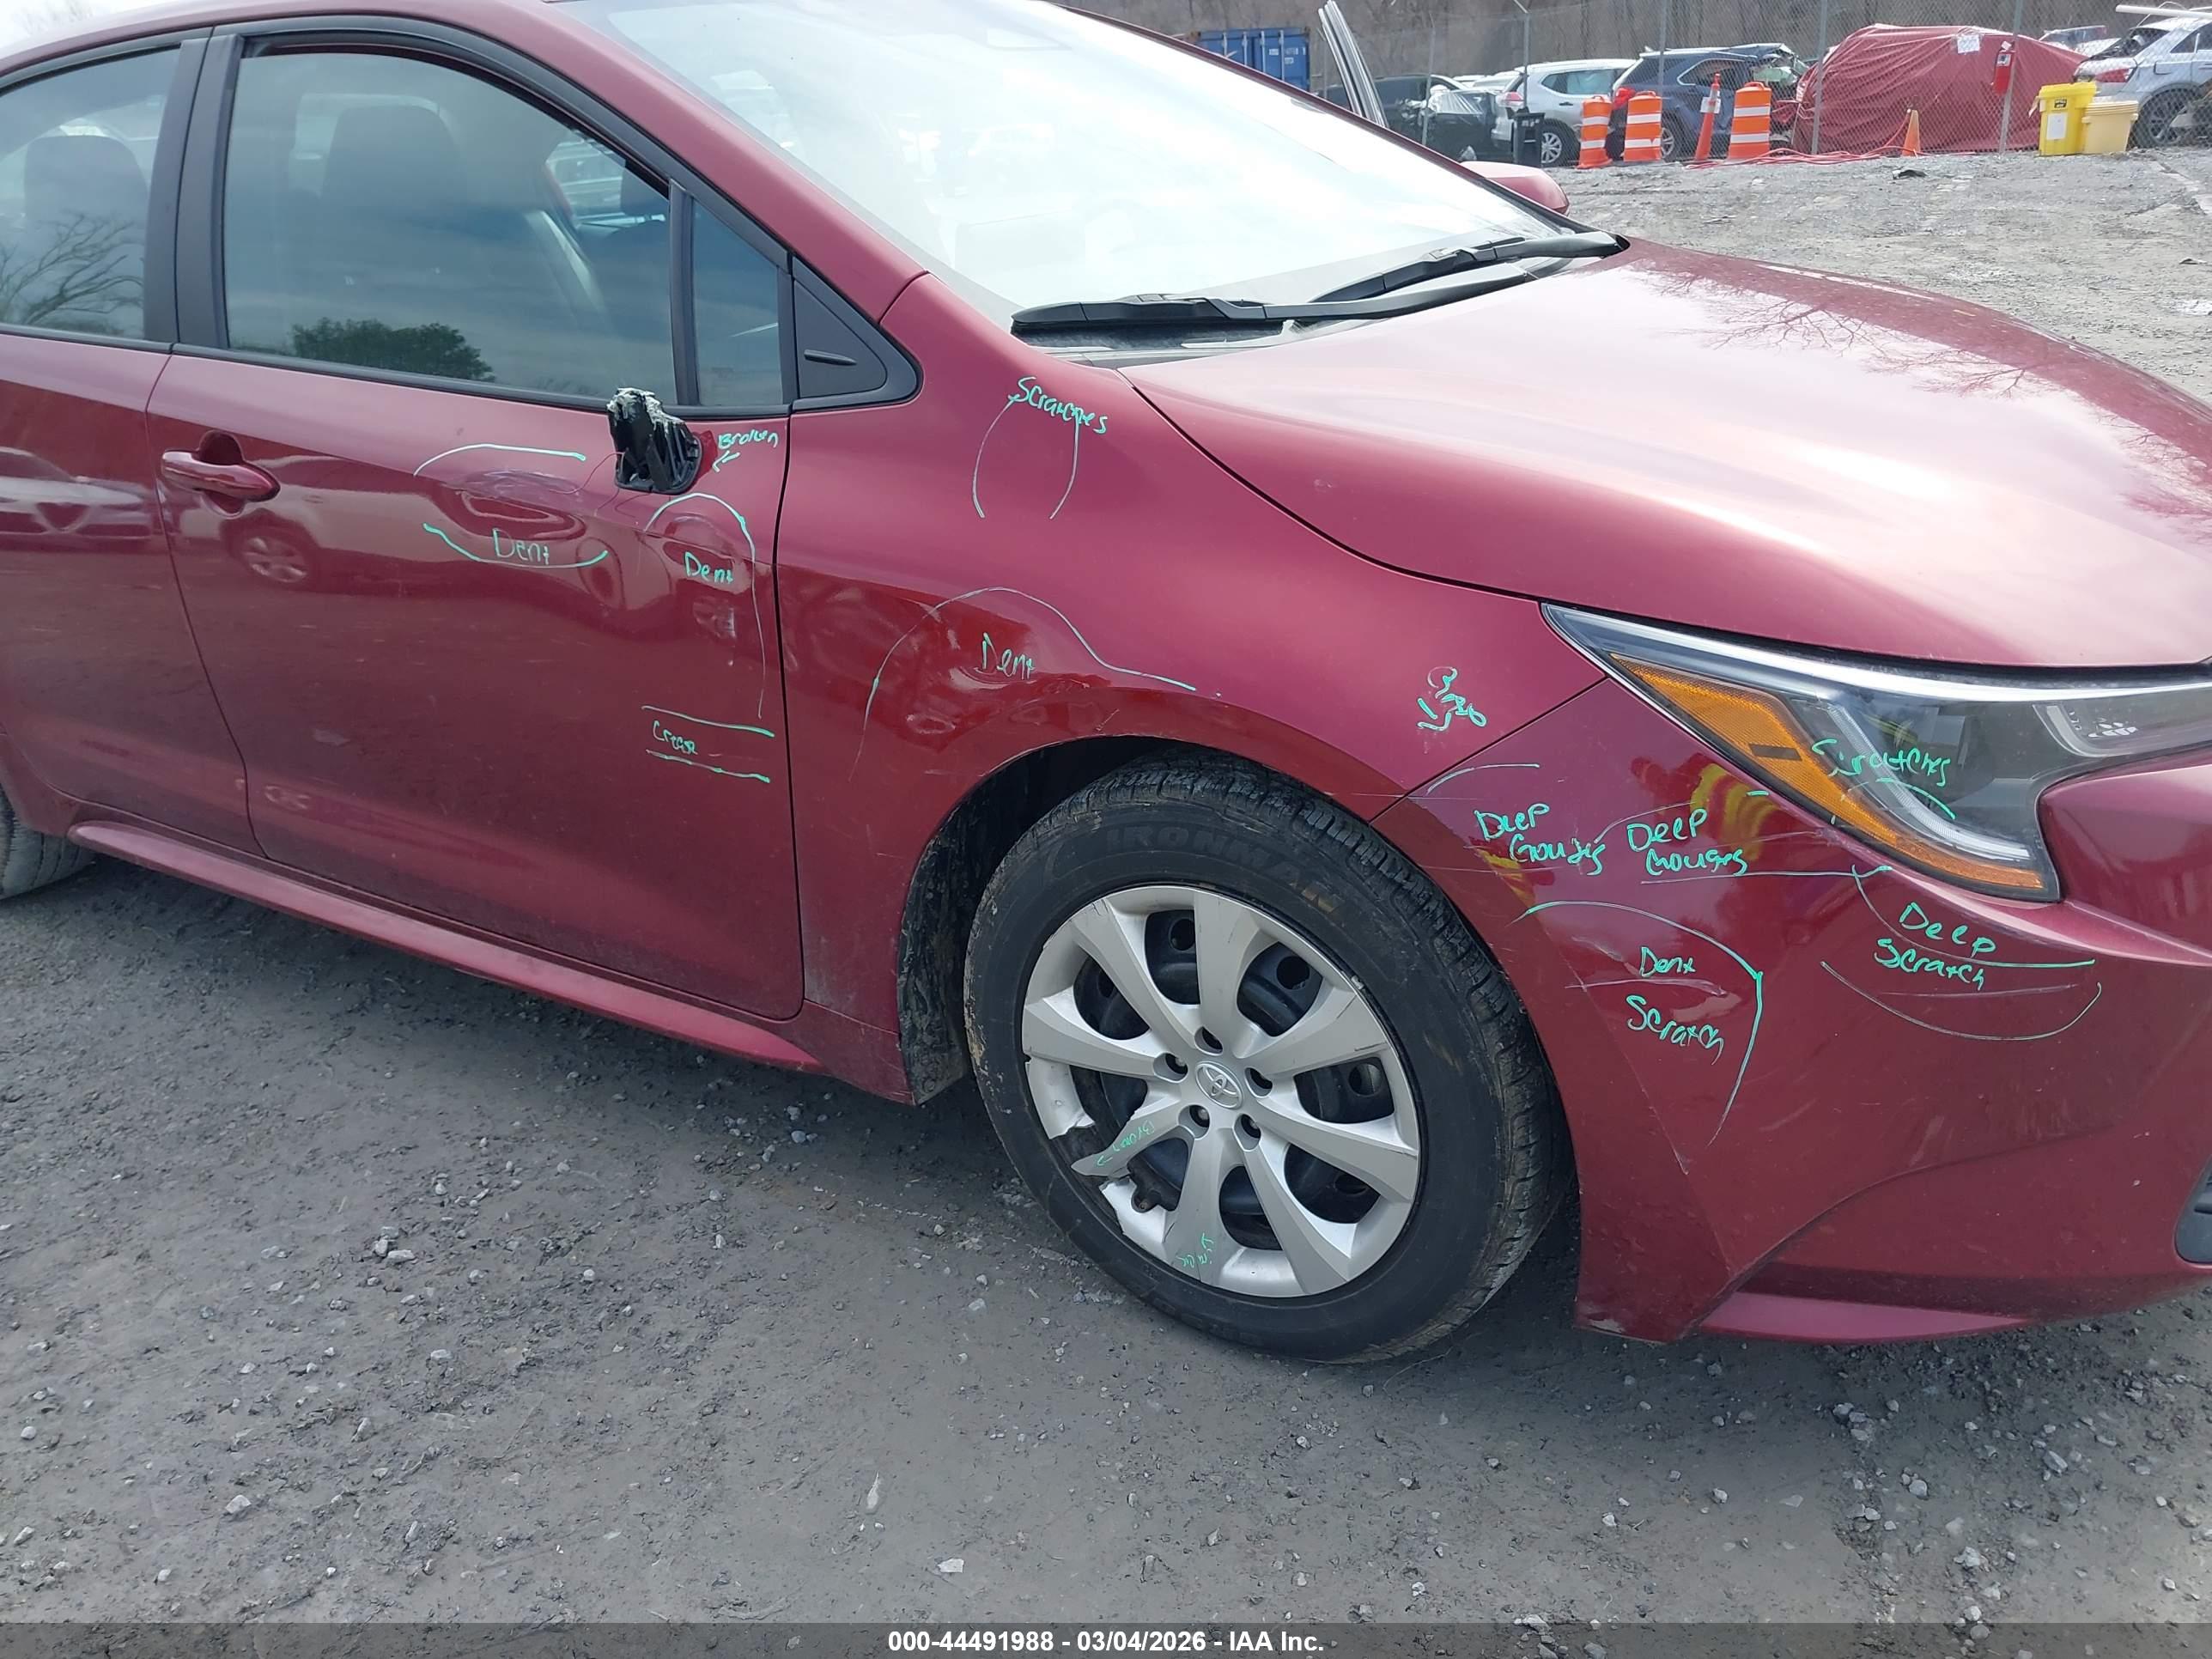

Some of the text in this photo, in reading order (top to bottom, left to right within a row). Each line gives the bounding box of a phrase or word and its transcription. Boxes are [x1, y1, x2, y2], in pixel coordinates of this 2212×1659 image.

[492, 527, 550, 566] Dent
[684, 550, 734, 585] Dent
[1639, 946, 1696, 977] Dent
